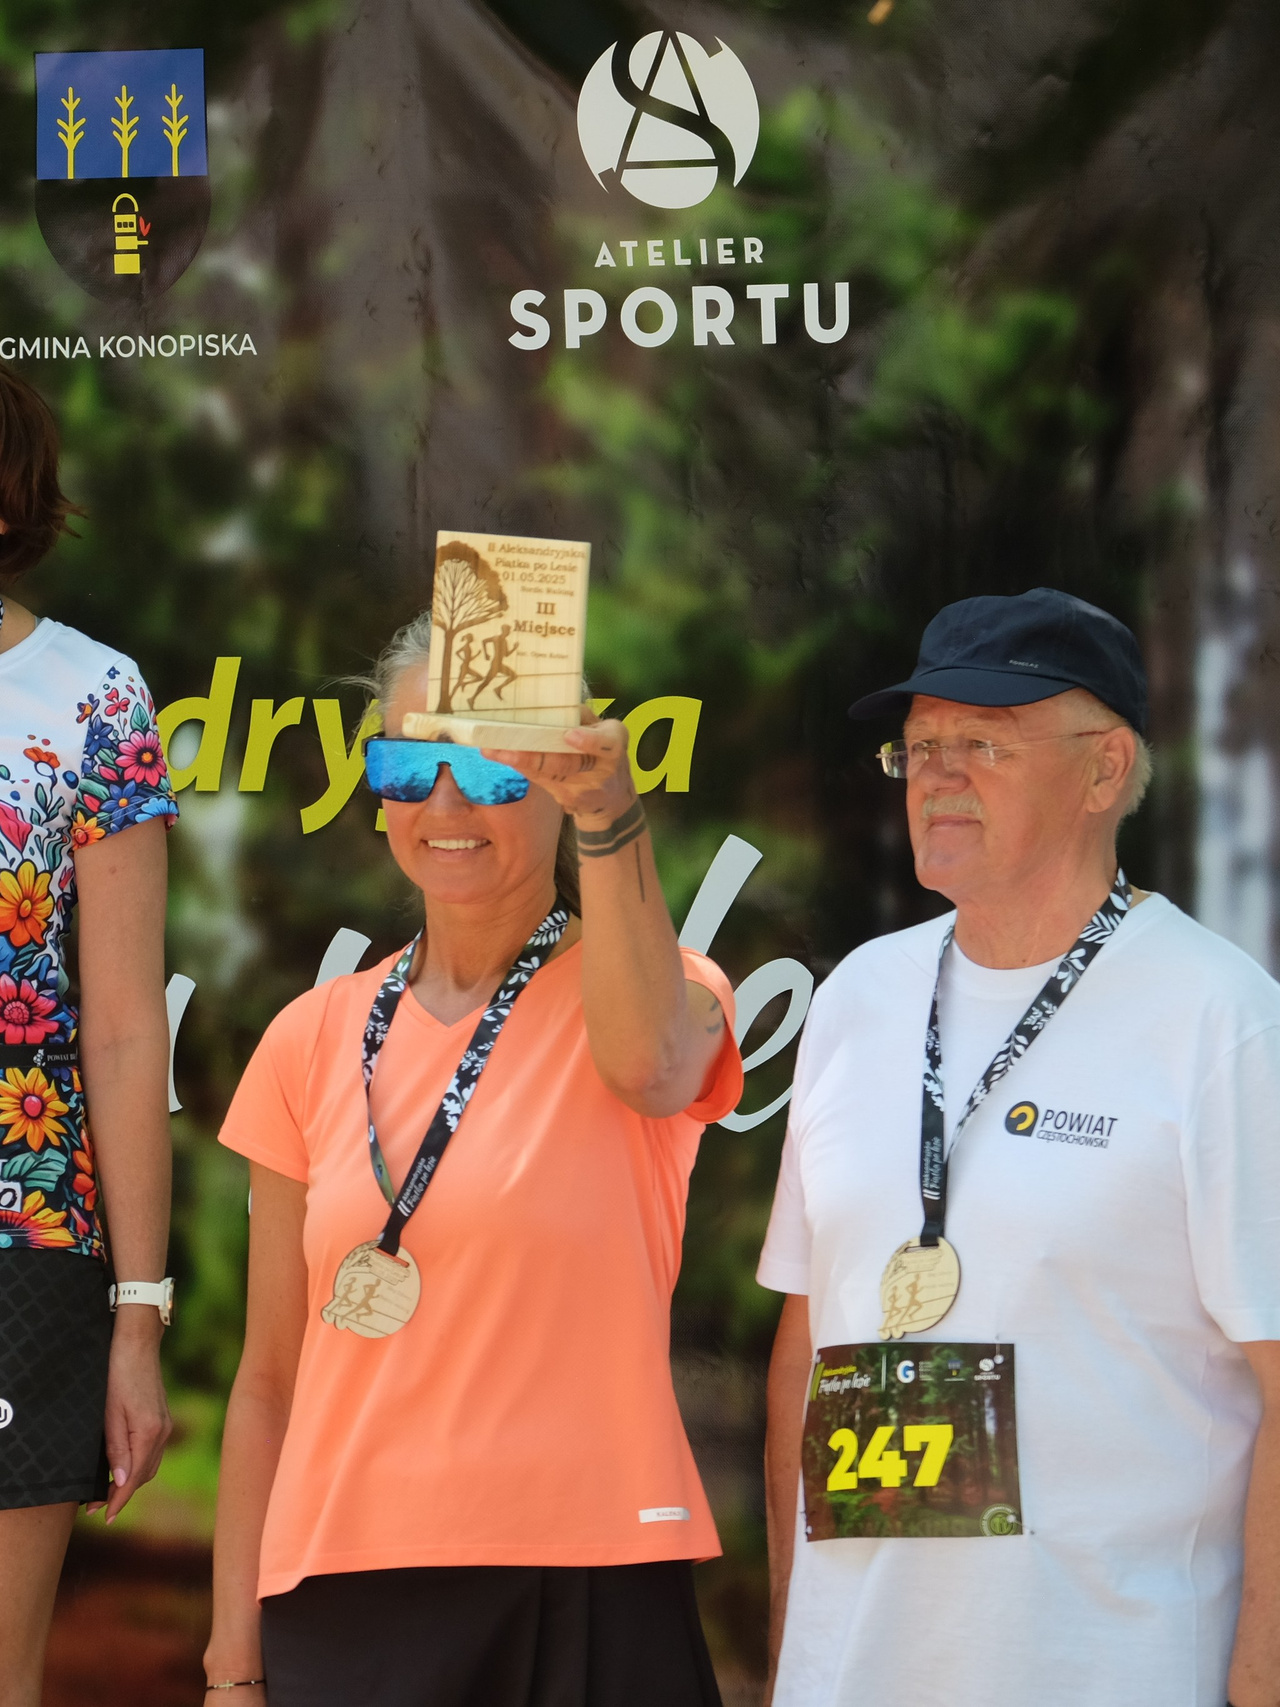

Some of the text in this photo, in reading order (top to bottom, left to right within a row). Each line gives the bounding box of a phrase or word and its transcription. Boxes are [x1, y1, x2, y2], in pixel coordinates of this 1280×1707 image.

[594, 237, 764, 268] ATELIER
[508, 282, 850, 350] SPORTU
[99, 333, 258, 358] KONOPISKA
[502, 572, 565, 584] 01.05.2025
[534, 562, 548, 572] po
[550, 561, 578, 572] Lesie
[536, 602, 555, 615] III
[513, 620, 575, 638] Miejsce
[1041, 1109, 1118, 1137] POWIAT
[827, 1424, 953, 1491] 247
